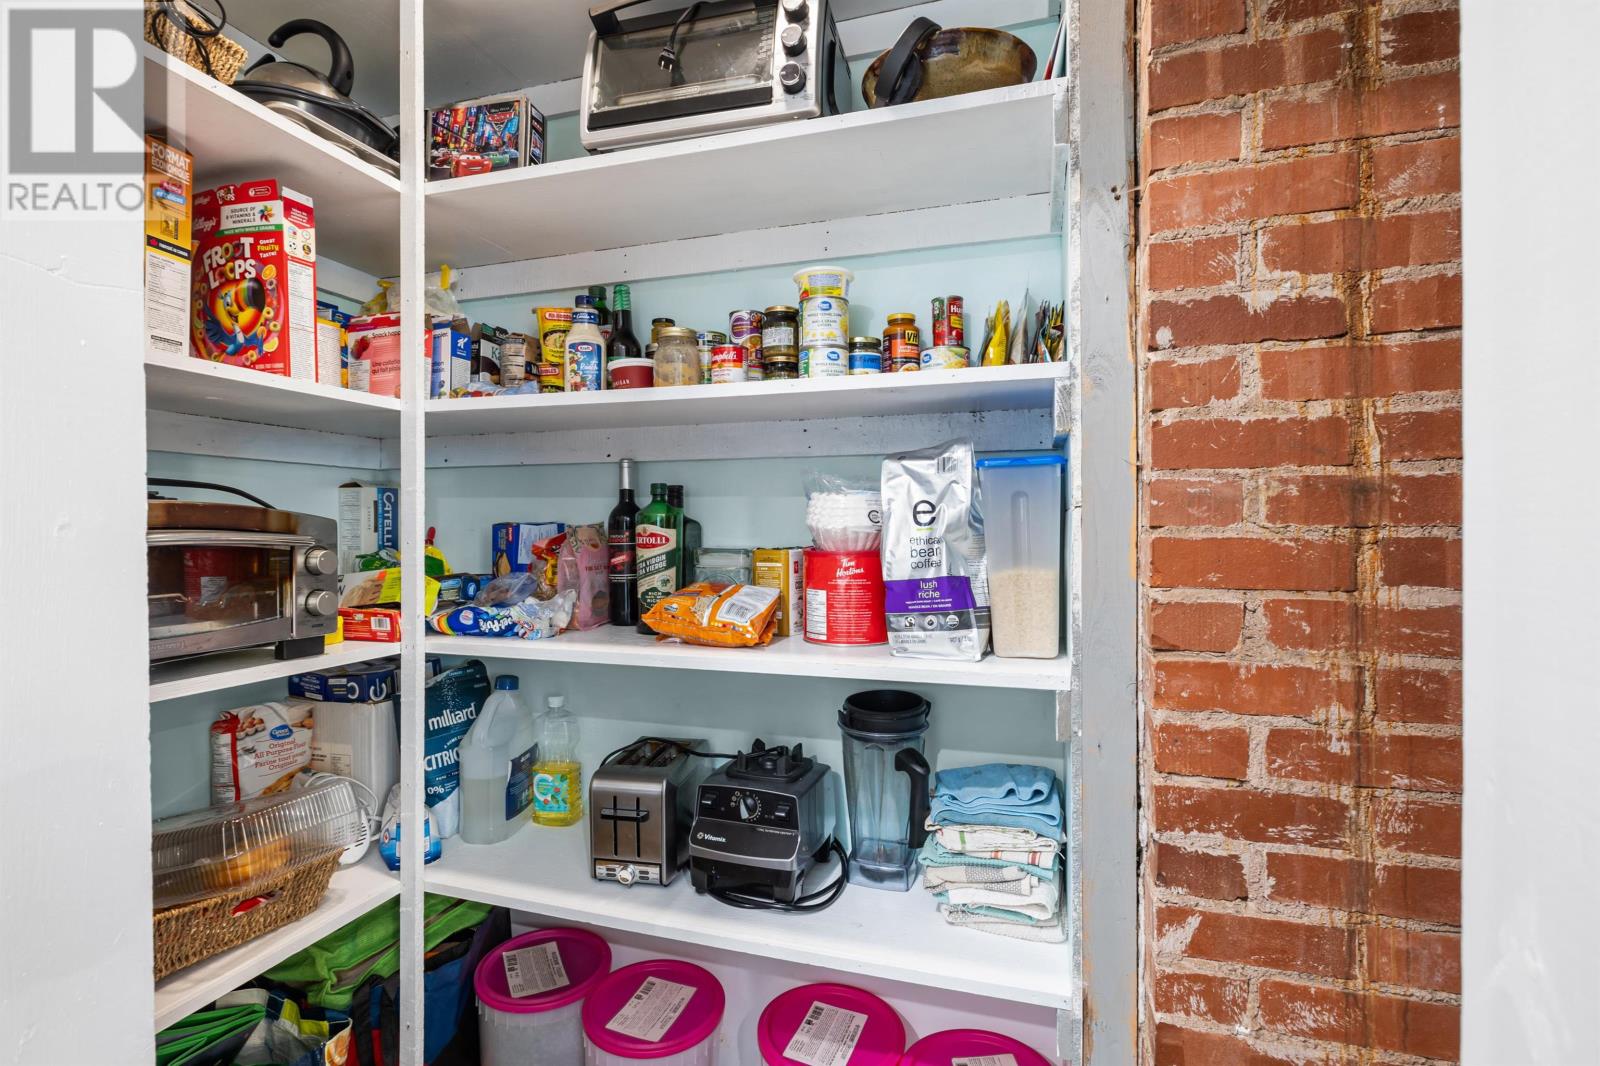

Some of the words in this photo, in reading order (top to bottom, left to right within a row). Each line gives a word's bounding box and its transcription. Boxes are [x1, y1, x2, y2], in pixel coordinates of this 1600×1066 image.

[152, 142, 190, 171] FORMAT
[203, 237, 254, 273] FROOT
[208, 259, 257, 290] LOOPS
[712, 351, 736, 362] ampbell's
[384, 492, 394, 545] CATELLI
[647, 554, 666, 566] VIRGIN
[841, 558, 855, 567] Tim
[911, 559, 942, 570] coffee
[646, 561, 667, 572] VIERGE
[836, 567, 864, 577] Hortons
[920, 580, 937, 589] lush
[918, 590, 940, 598] riche
[428, 702, 476, 731] milliard
[269, 738, 295, 749] Original
[266, 747, 292, 756] Purpose
[255, 760, 277, 768] Farine
[427, 785, 445, 794] 0%
